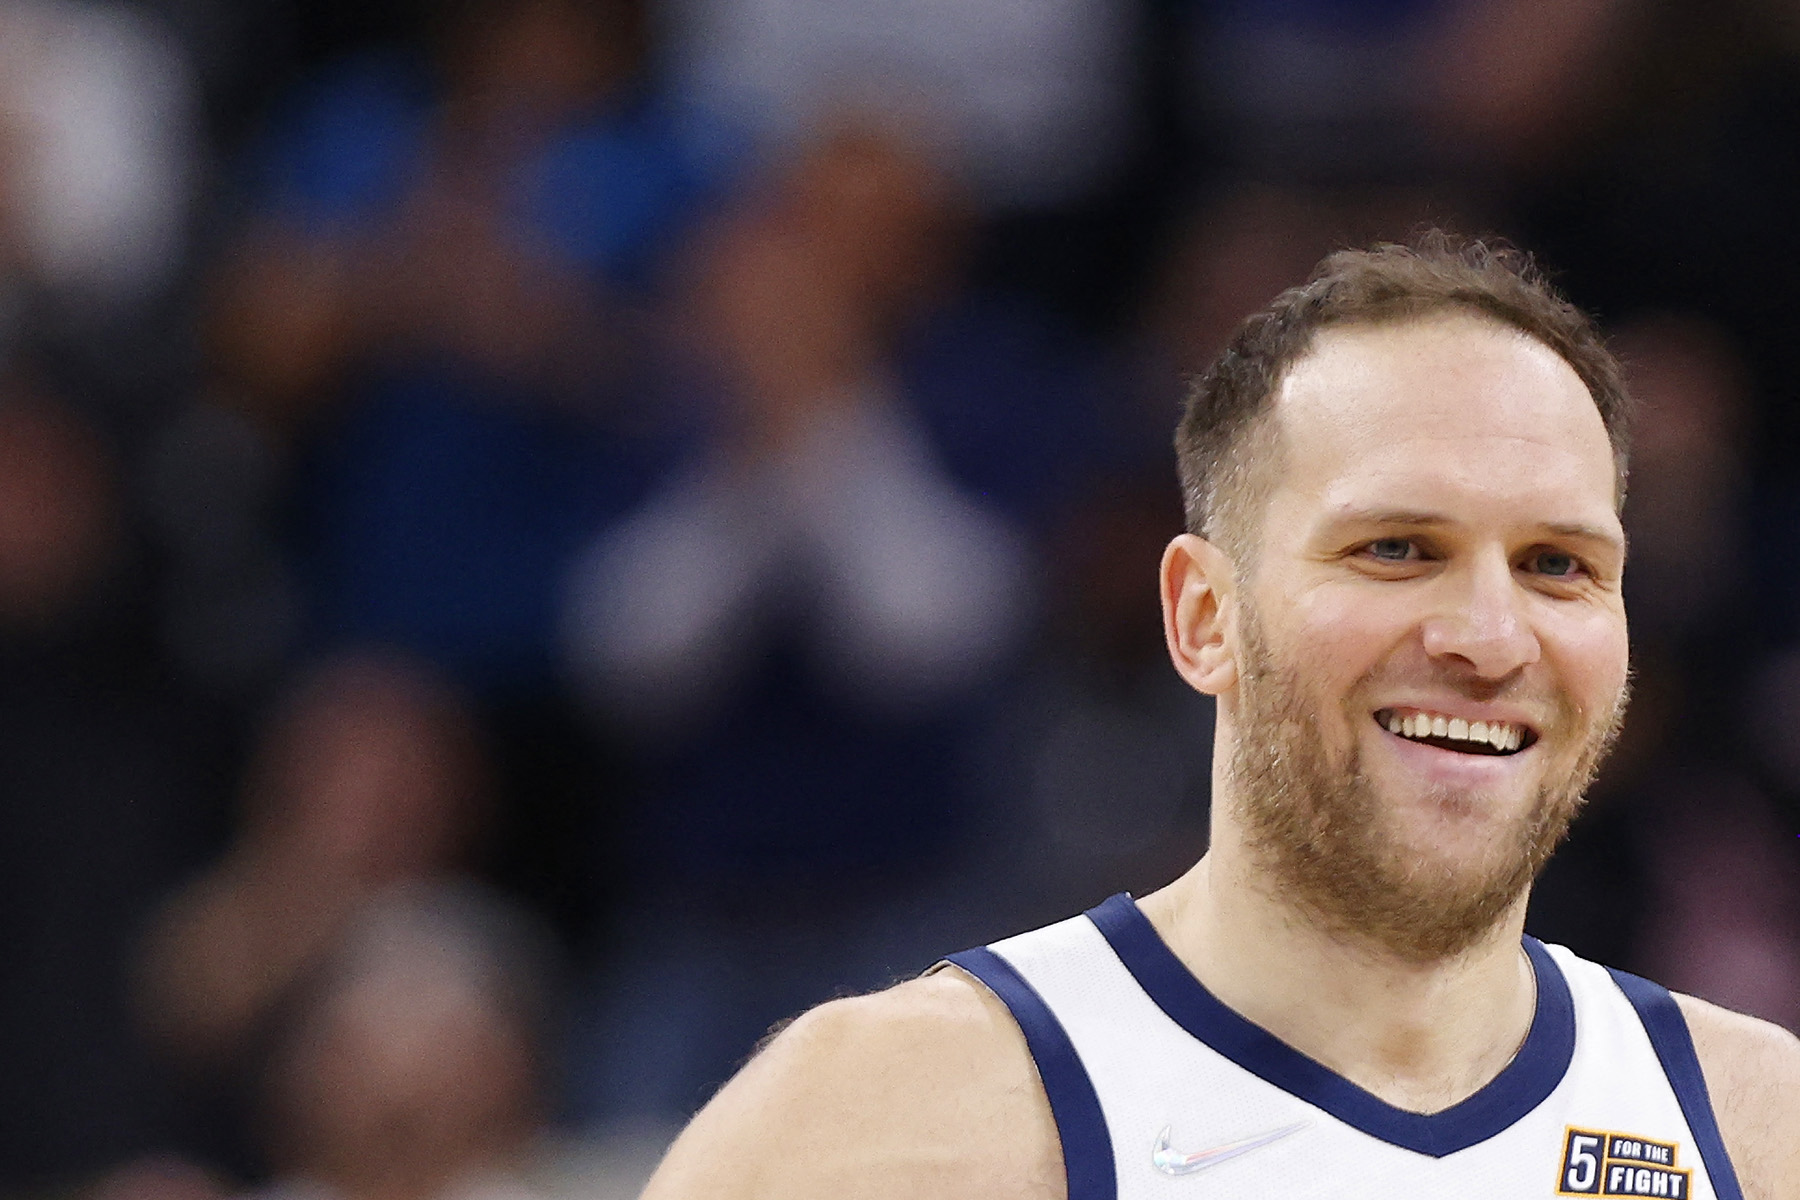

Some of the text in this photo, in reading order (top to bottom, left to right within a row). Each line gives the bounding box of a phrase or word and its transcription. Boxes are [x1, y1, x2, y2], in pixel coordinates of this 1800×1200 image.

[1567, 1135, 1598, 1191] 5
[1613, 1139, 1669, 1162] FOR THE
[1608, 1166, 1682, 1198] FIGHT
